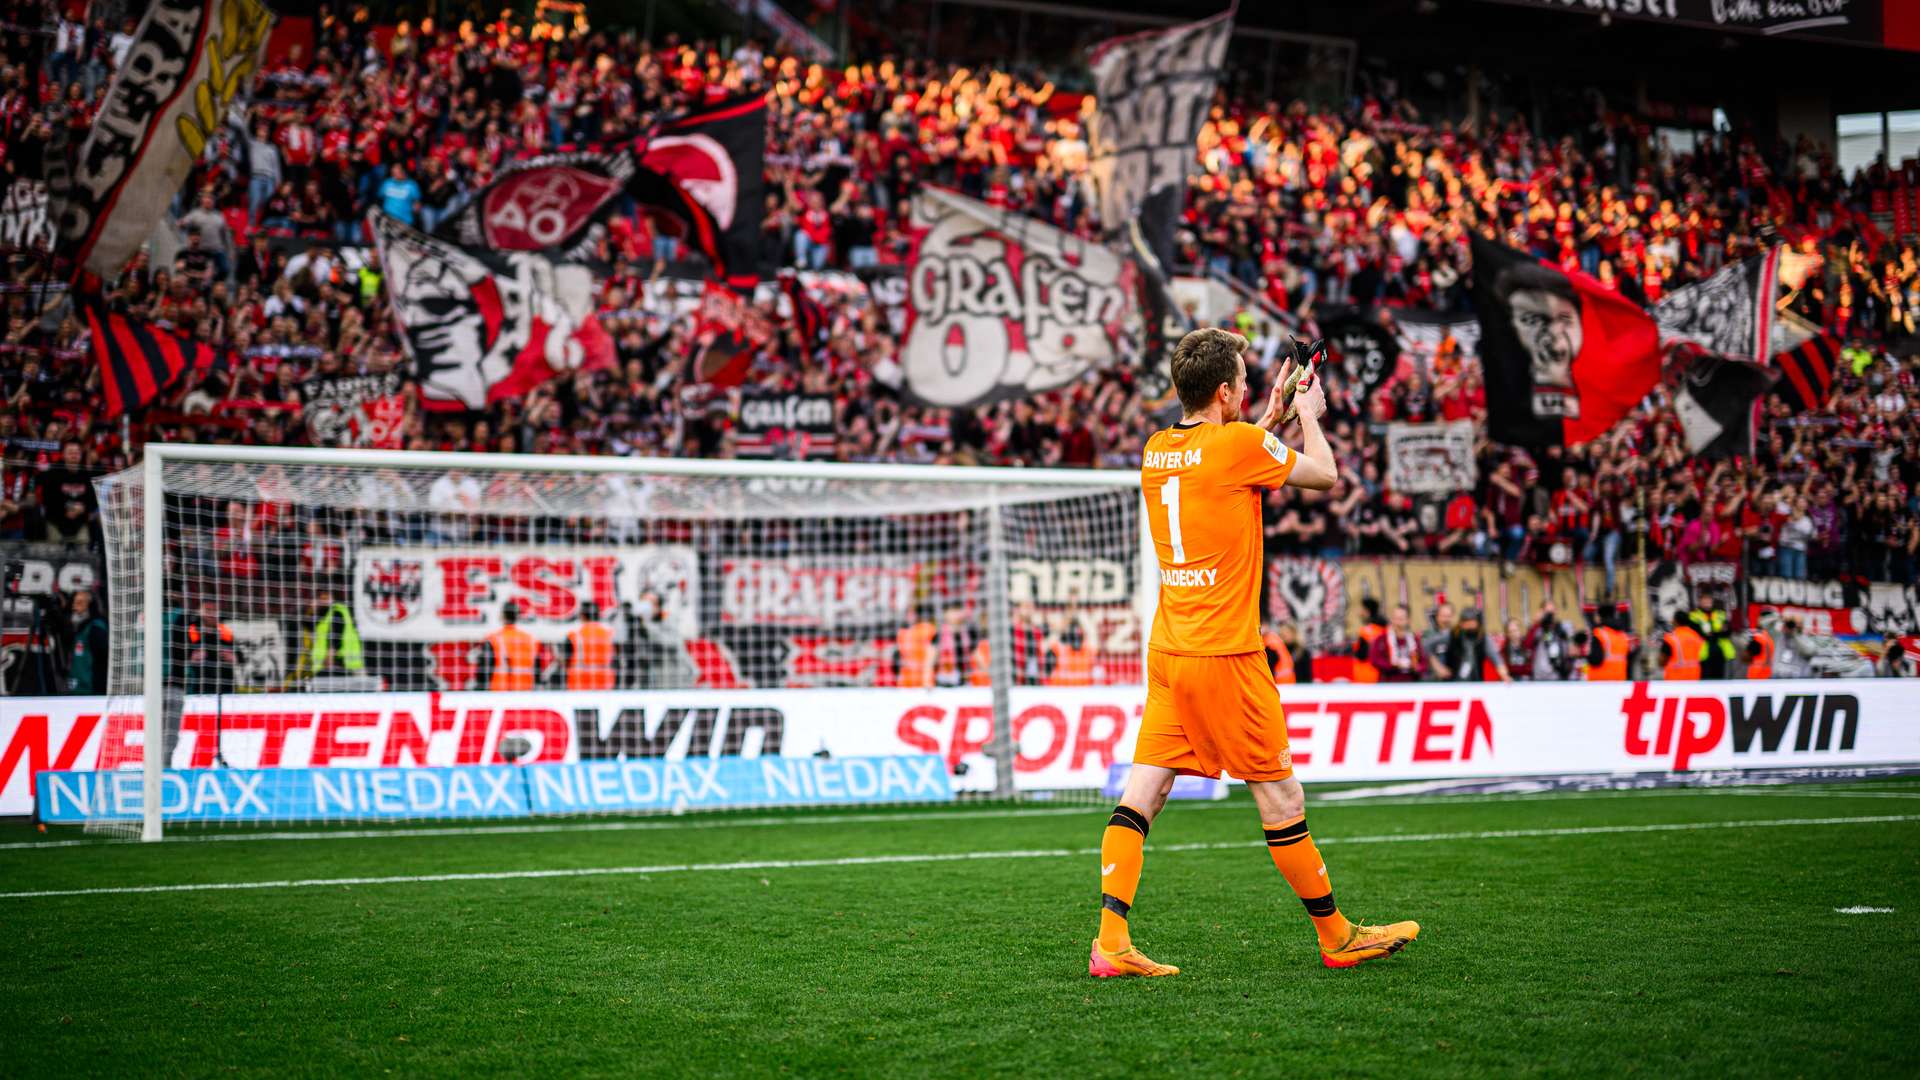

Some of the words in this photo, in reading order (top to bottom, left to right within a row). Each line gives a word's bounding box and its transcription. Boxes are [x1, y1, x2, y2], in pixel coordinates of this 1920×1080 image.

[1144, 450, 1183, 469] BAYER
[1184, 448, 1202, 466] 04
[1161, 476, 1185, 563] 1
[48, 772, 269, 816] NIEDAX
[312, 769, 519, 813] NIEDAX
[534, 759, 729, 808] NIEDAX
[761, 757, 945, 799] NIEDAX
